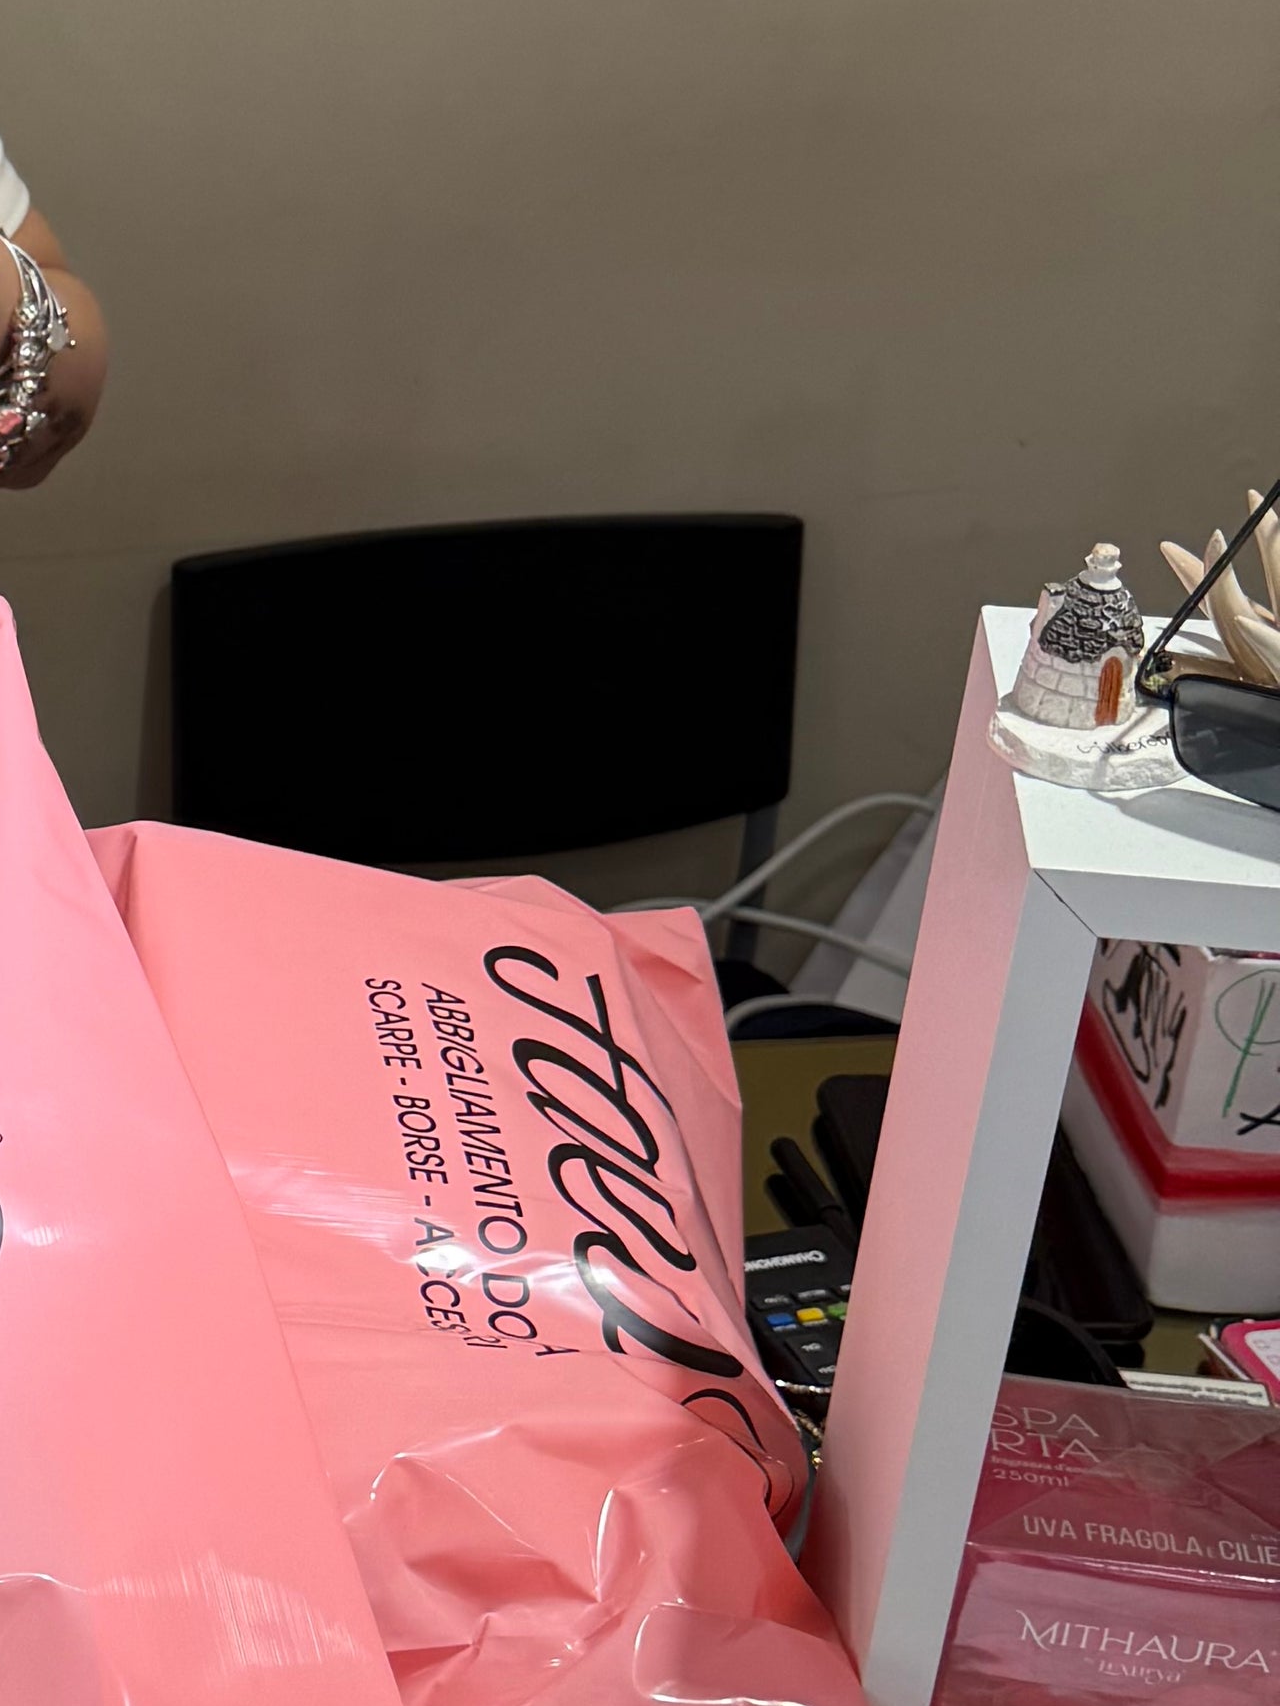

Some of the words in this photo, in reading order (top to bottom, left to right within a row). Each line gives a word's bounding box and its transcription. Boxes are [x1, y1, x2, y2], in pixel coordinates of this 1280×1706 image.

[365, 977, 422, 1070] SCARPE
[392, 1094, 448, 1184] BORSE
[421, 983, 528, 1255] ABBIGLIAMENTO
[482, 1274, 579, 1356] DOA
[483, 945, 744, 1379] Faev
[1023, 1515, 1077, 1541] UVA
[1085, 1522, 1203, 1557] FRAGOLA
[1016, 1609, 1271, 1674] MITHAURA
